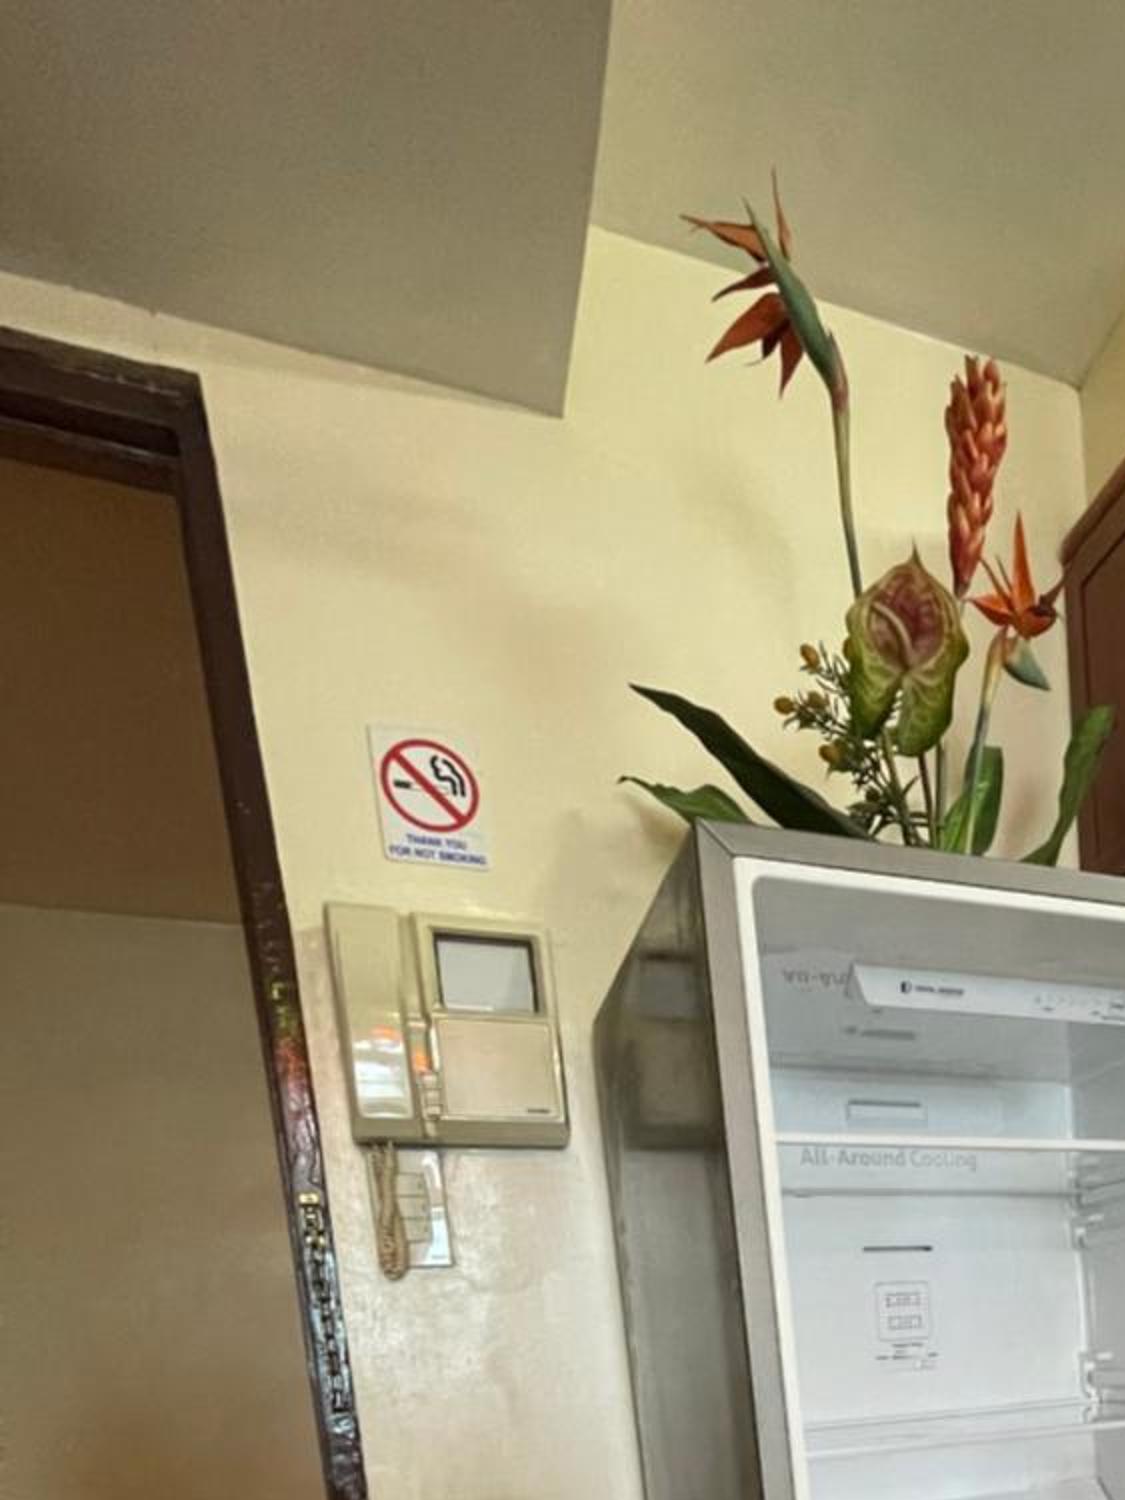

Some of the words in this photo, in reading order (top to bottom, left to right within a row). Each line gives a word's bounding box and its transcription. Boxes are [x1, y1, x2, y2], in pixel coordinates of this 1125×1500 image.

[405, 833, 443, 846] THANK
[446, 838, 467, 850] YOU
[389, 845, 411, 856] FOR
[414, 848, 435, 859] NOT
[438, 850, 487, 865] SMOKING
[800, 1147, 905, 1168] All-Around
[911, 1149, 977, 1173] Cooling
